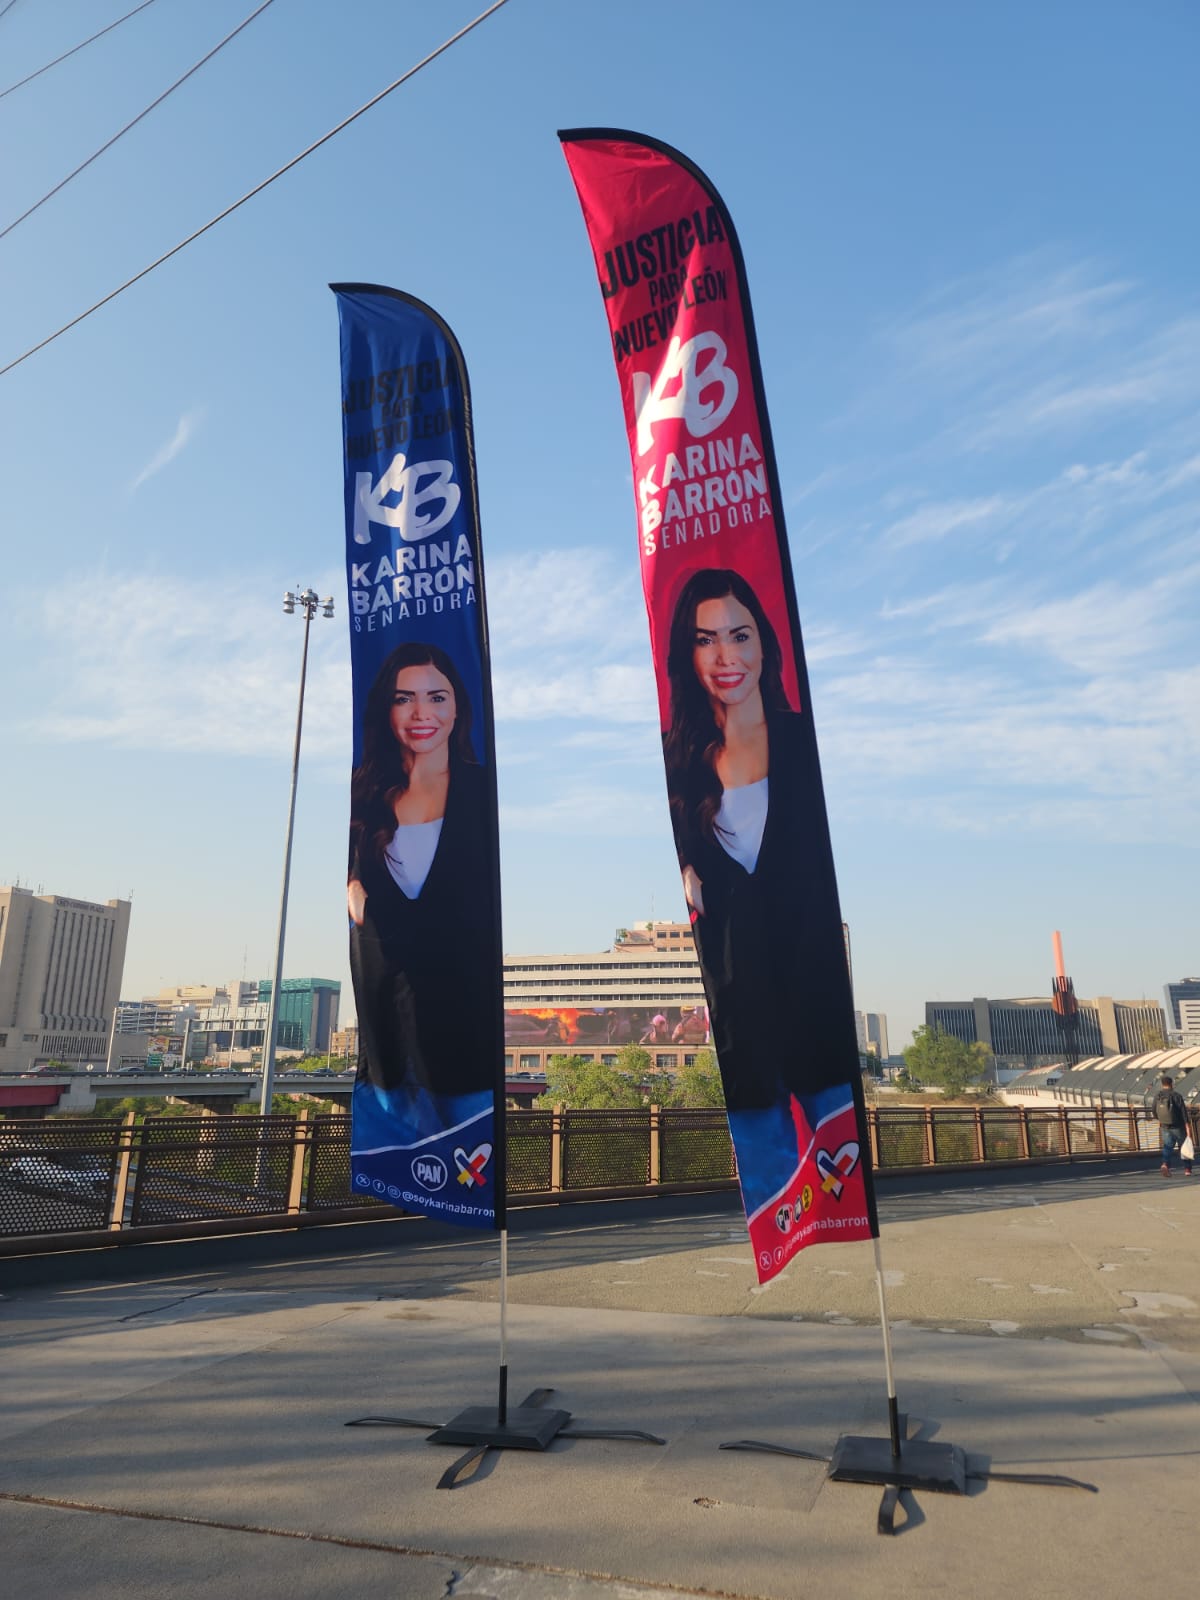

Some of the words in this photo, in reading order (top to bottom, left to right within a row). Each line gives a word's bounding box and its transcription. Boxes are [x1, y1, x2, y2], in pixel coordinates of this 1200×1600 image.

[601, 205, 725, 299] JUSTICIA
[648, 264, 688, 308] PARA
[682, 265, 727, 312] LEÓN
[344, 357, 457, 414] JUSTICIA
[632, 330, 739, 457] KB
[353, 453, 461, 544] KB
[639, 433, 761, 508] KARINA
[642, 463, 767, 538] BARRÓN
[644, 497, 772, 556] SENADORA
[351, 533, 473, 588] KARINA
[351, 561, 475, 615] BARRÓN
[354, 589, 477, 633] SENADORA
[416, 1162, 442, 1184] PAN
[402, 1191, 495, 1218] @soykarinabarron
